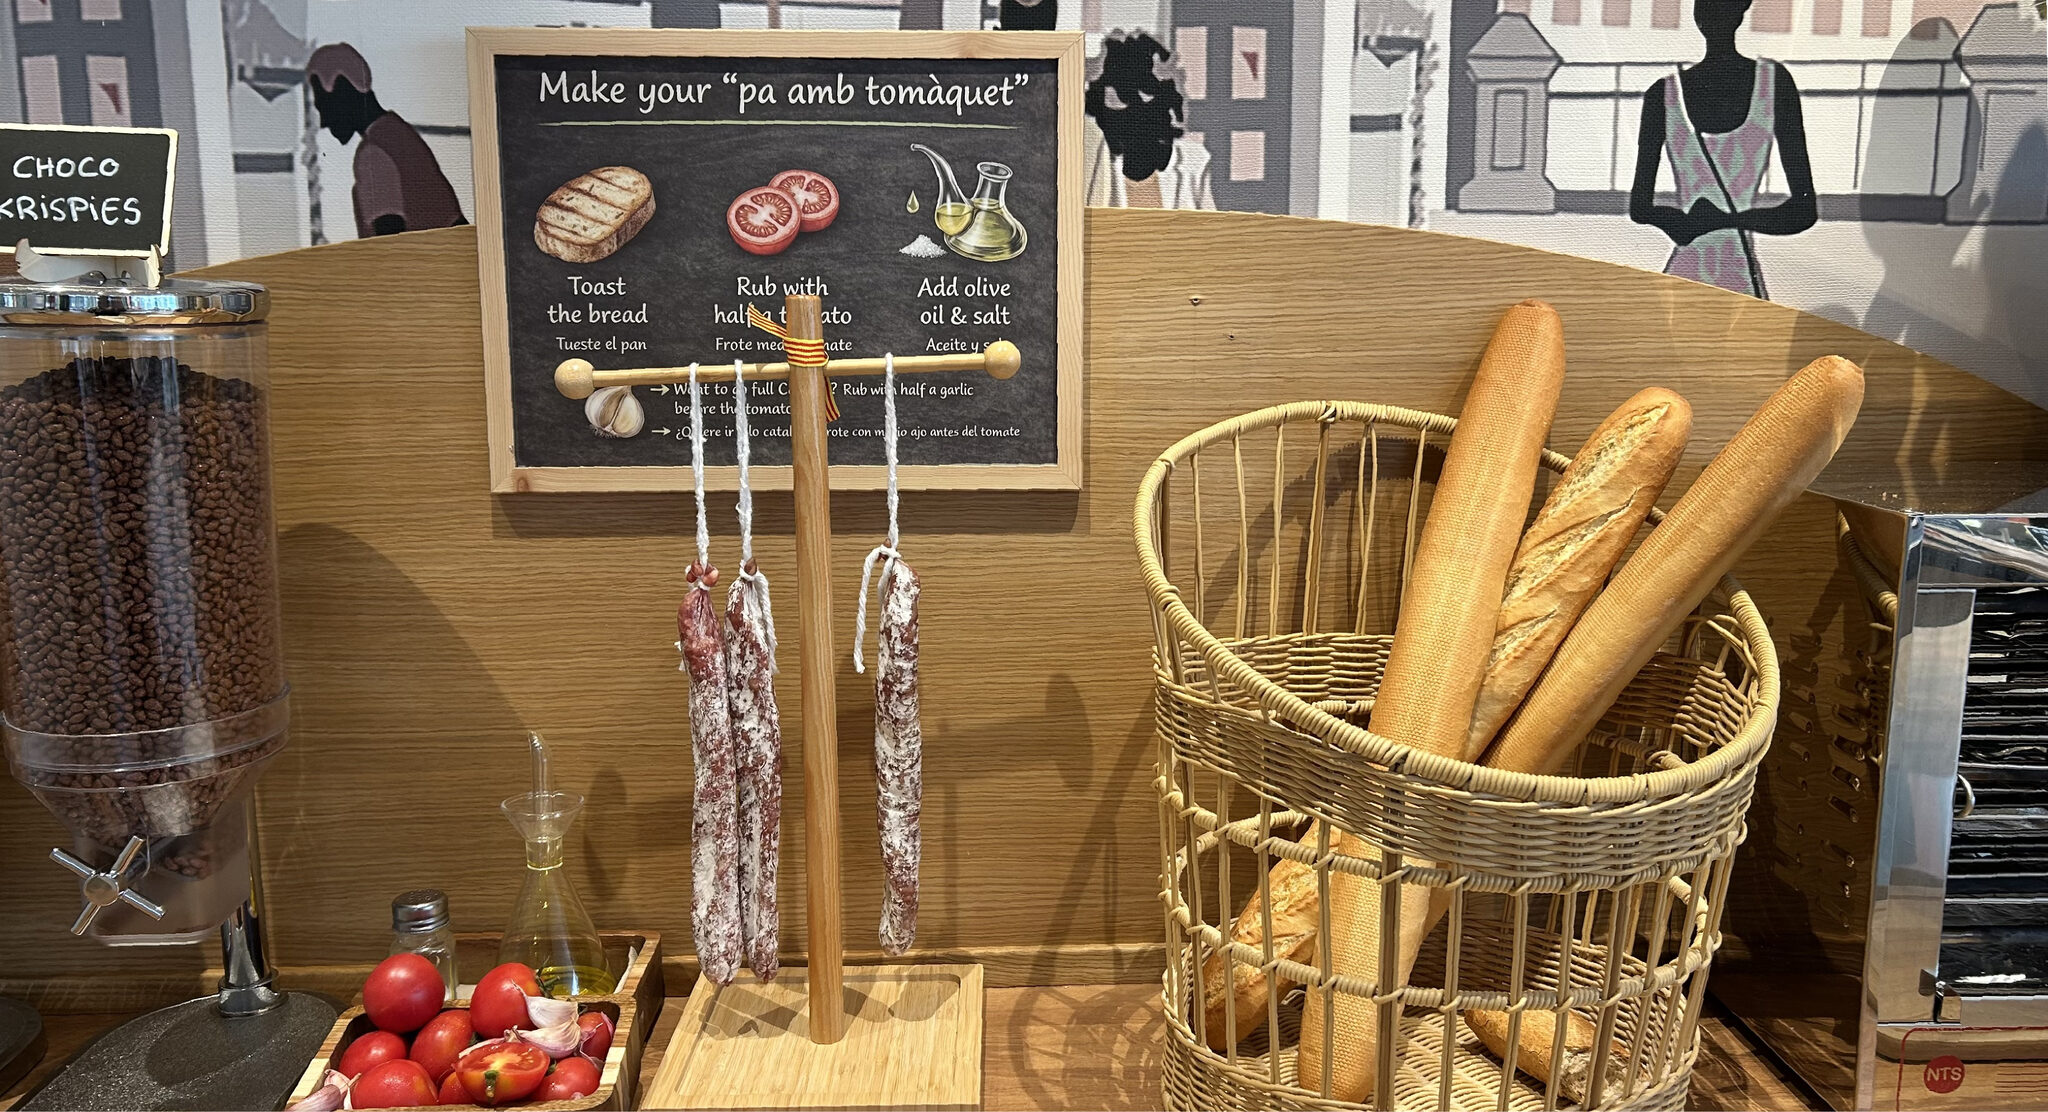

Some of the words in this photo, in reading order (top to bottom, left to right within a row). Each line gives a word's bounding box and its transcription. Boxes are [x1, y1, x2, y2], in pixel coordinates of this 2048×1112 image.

[540, 69, 627, 103] Make
[638, 83, 712, 114] your
[722, 72, 777, 114] “pa
[788, 72, 855, 105] amb
[865, 73, 1029, 116] tomàquet”
[13, 155, 120, 178] CHOCO
[567, 276, 627, 295] Toast
[737, 275, 777, 296] Rub
[783, 275, 829, 296] with
[917, 275, 959, 298] Add
[964, 276, 1011, 297] olive
[547, 303, 582, 323] the
[588, 303, 649, 324] bread
[779, 305, 852, 324] tato
[920, 304, 944, 325] oil
[950, 306, 967, 325] &
[973, 303, 1011, 325] salt
[555, 336, 601, 350] Tueste
[605, 336, 617, 350] el
[621, 339, 647, 354] pan
[715, 337, 753, 351] Frote
[757, 338, 786, 351] med
[926, 337, 967, 351] Aceite
[971, 341, 979, 354] y
[714, 384, 728, 396] to
[751, 381, 774, 398] full
[843, 382, 868, 396] Rub
[900, 382, 926, 398] half
[929, 386, 937, 396] a
[940, 382, 974, 399] garlic
[674, 401, 716, 415] bere
[676, 425, 721, 440] ¿Qere
[725, 425, 735, 437] ir
[749, 424, 760, 437] lo
[826, 427, 849, 437] rote
[852, 429, 871, 437] con
[875, 426, 908, 437] mio
[910, 426, 927, 440] ajo
[930, 427, 959, 437] antes
[961, 425, 978, 437] del
[981, 426, 1021, 437] tomate
[1926, 1066, 1962, 1082] NTS
